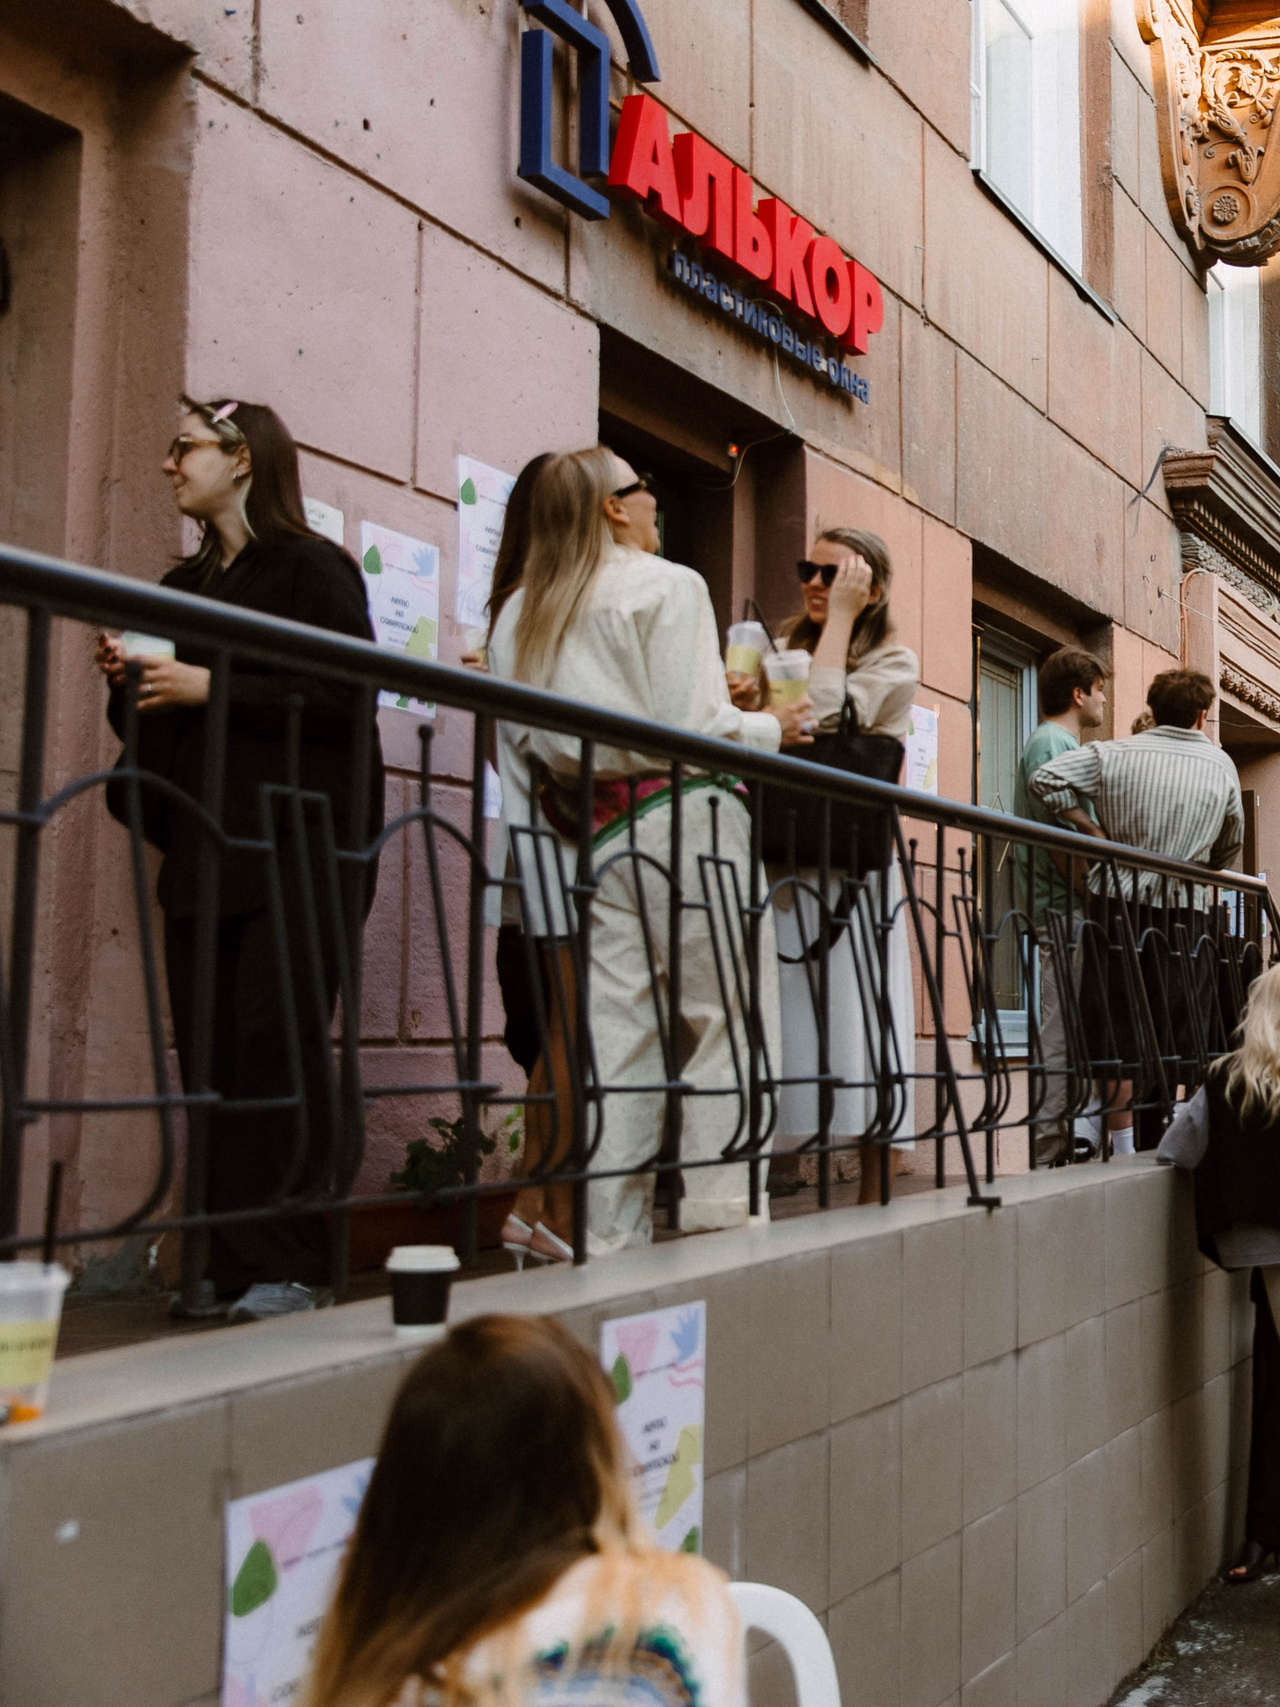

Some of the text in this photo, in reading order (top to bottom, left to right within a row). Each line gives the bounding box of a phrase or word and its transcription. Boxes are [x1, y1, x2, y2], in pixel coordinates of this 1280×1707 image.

[607, 93, 884, 356] АЛЬКОР
[674, 251, 869, 404] пластиковые окна
